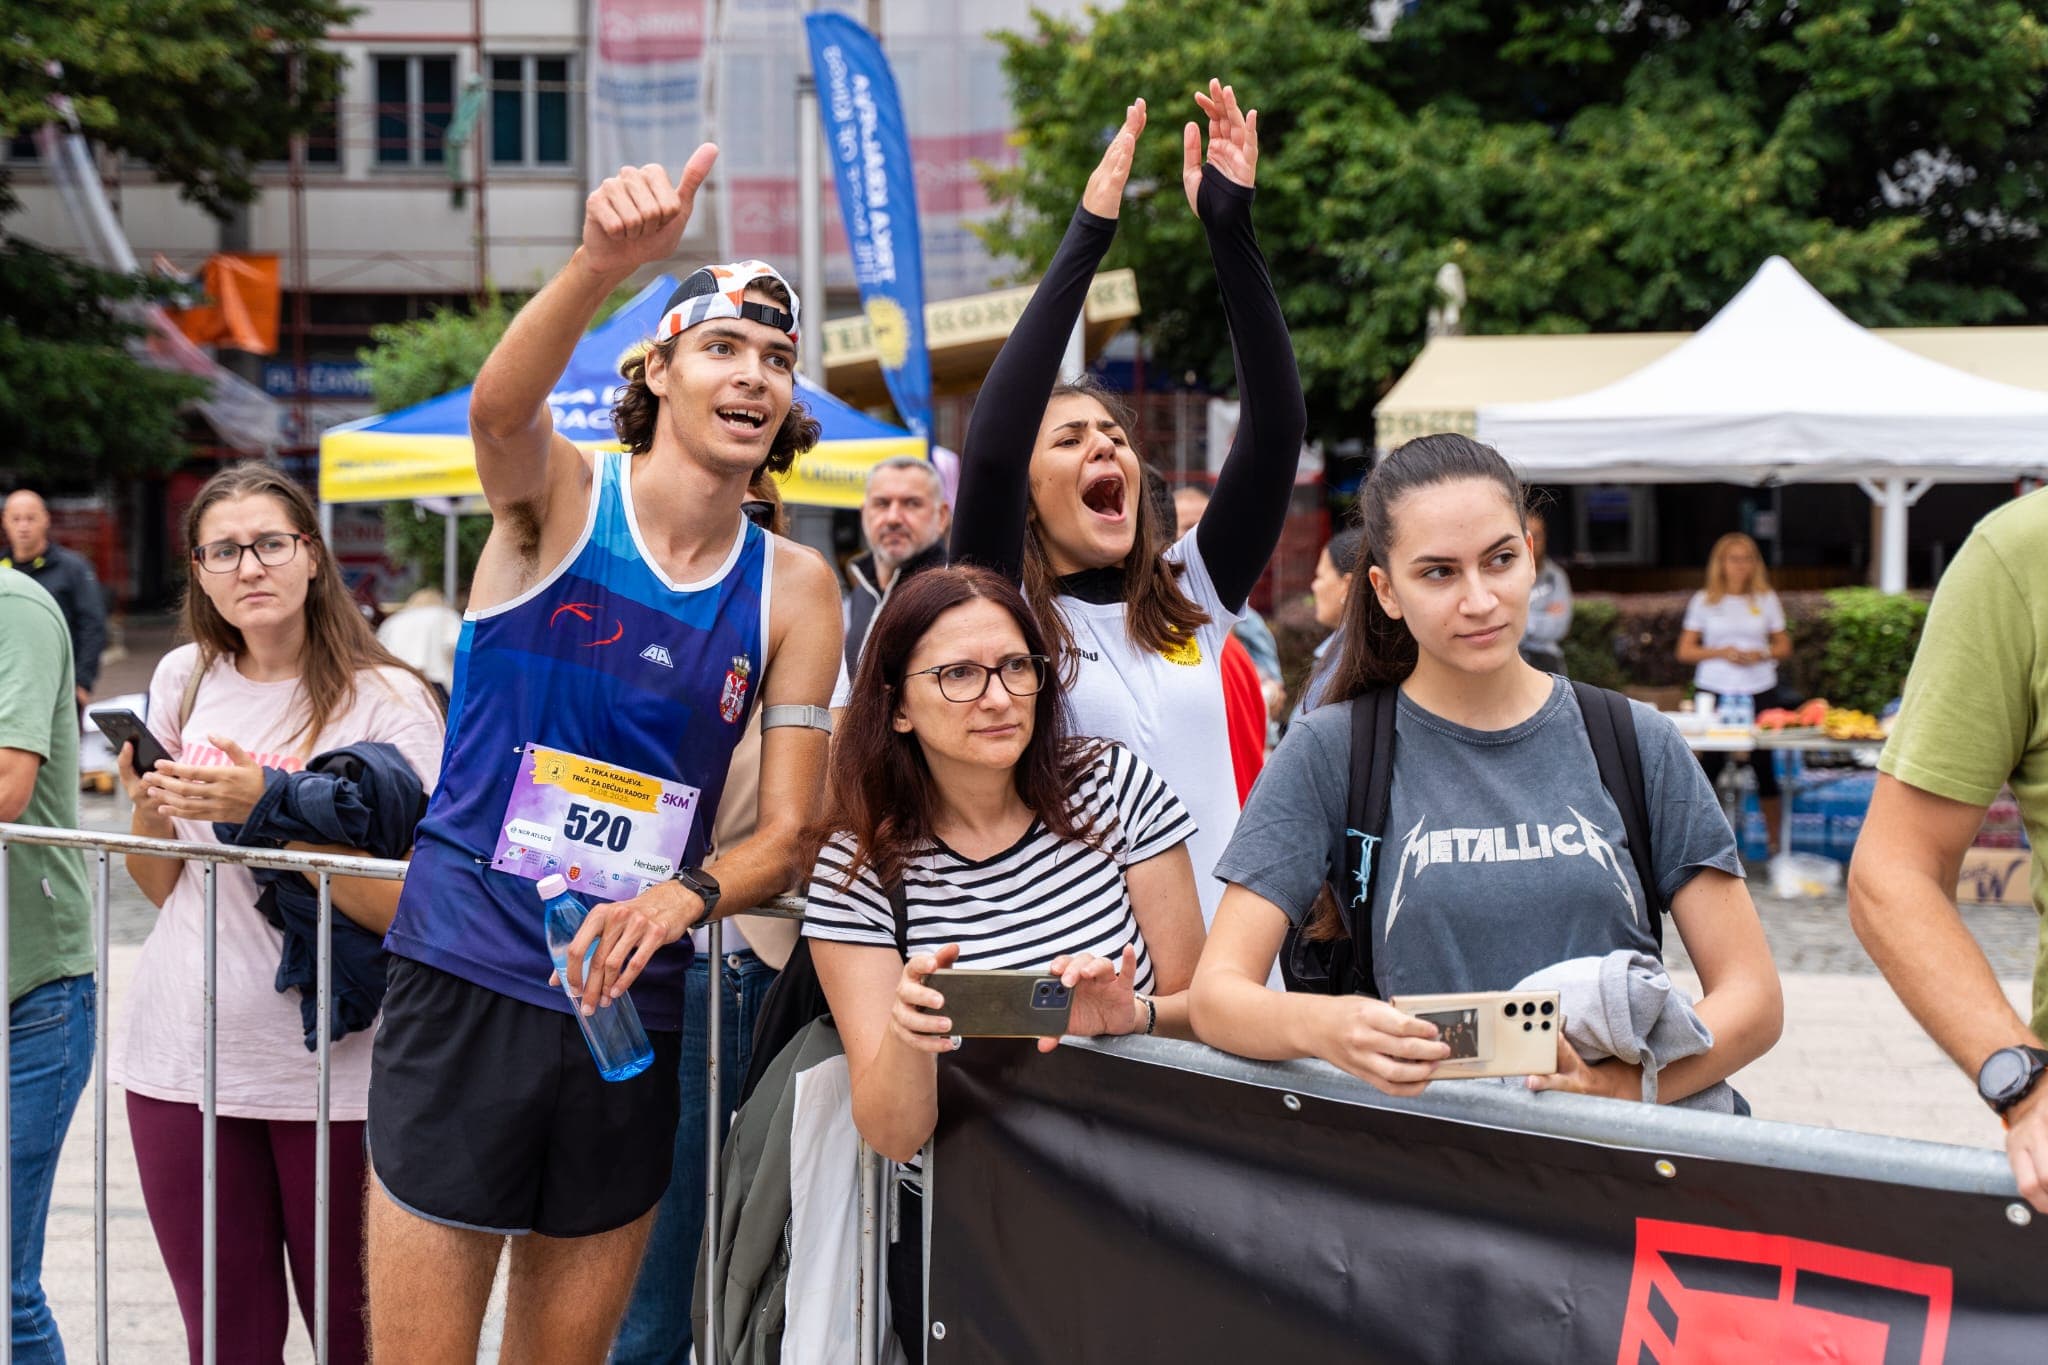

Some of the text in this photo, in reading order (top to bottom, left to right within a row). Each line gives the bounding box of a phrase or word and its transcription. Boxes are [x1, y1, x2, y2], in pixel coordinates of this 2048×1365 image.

[572, 774, 590, 784] TRKA
[590, 779, 601, 787] ZA
[624, 788, 650, 801] RADOST
[661, 792, 690, 810] 5KM
[563, 803, 632, 852] 520
[1385, 804, 1639, 944] METALLICA
